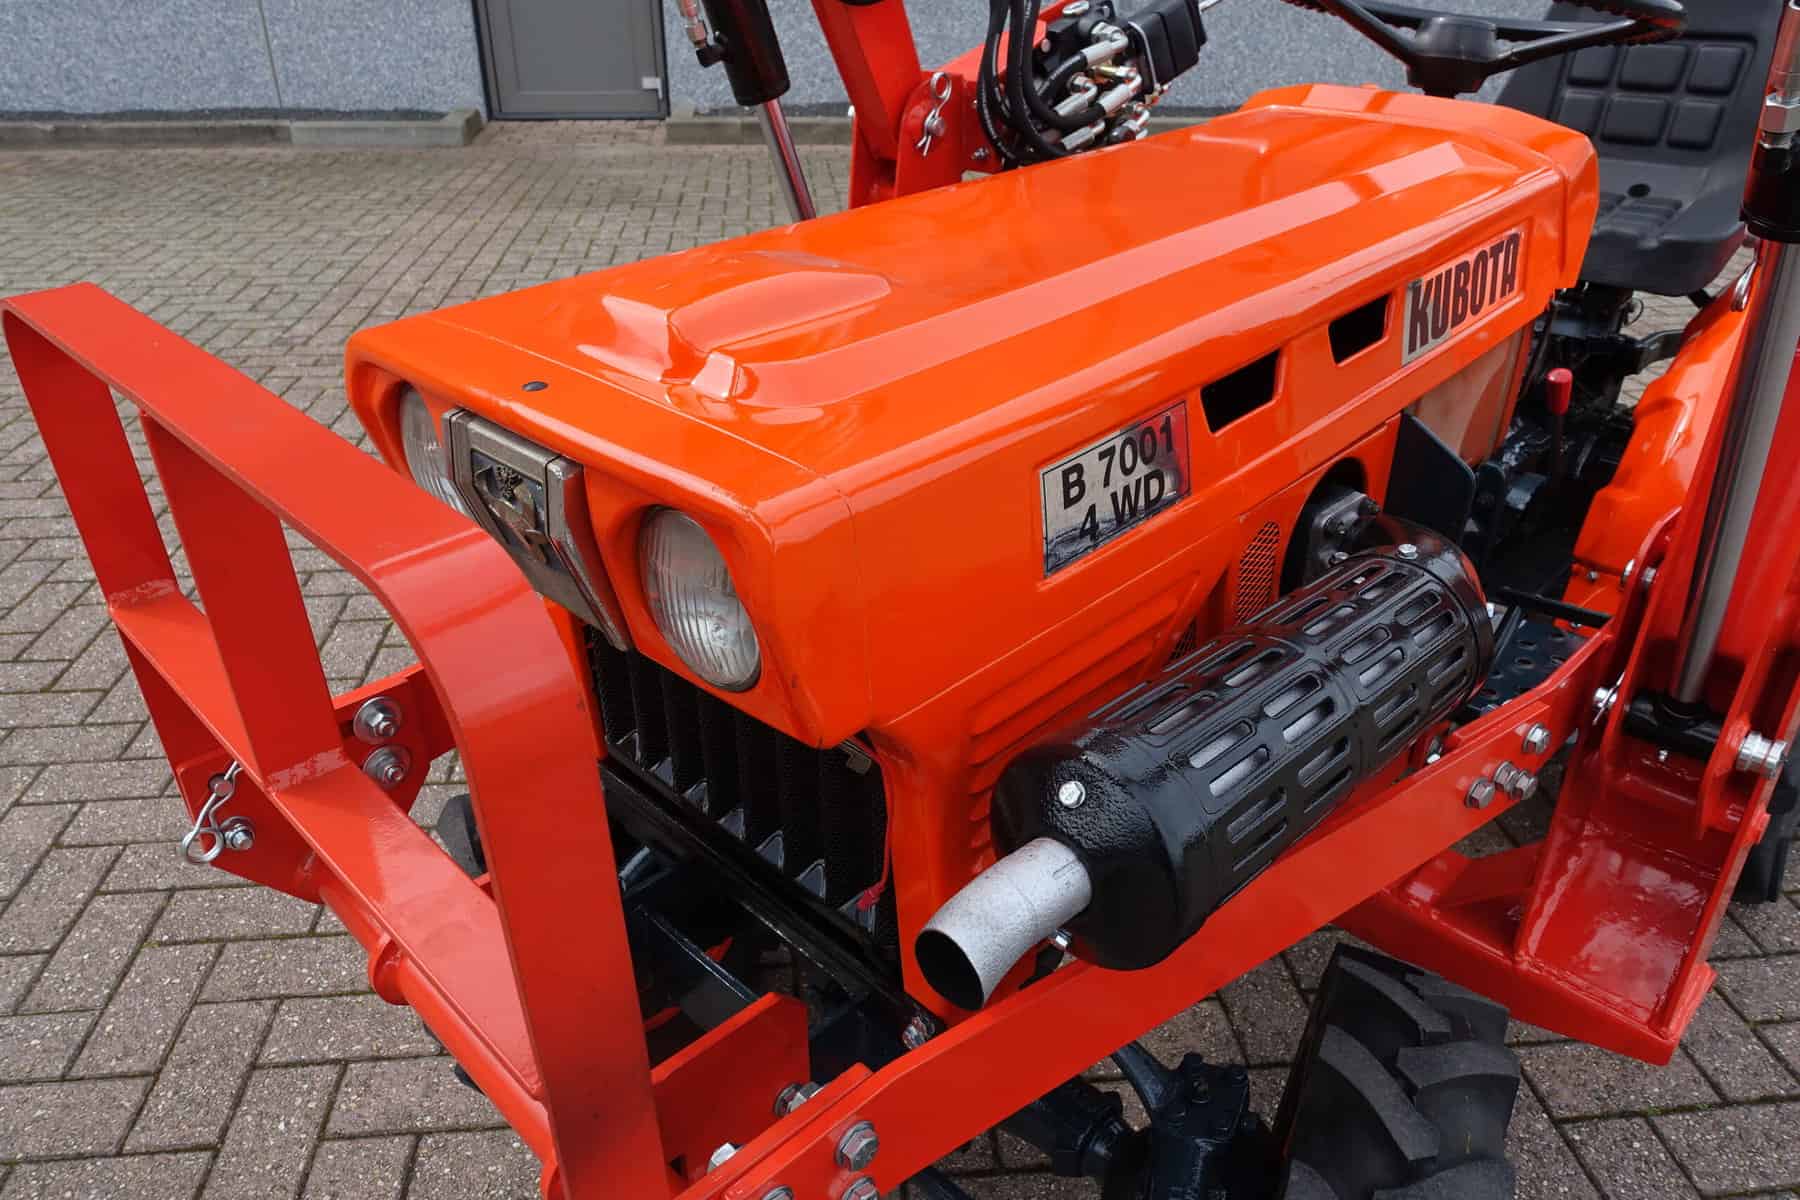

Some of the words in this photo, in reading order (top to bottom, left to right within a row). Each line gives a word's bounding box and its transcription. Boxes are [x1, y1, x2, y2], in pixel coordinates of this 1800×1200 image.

[1408, 233, 1520, 355] KUBOTA
[1062, 462, 1086, 510] B
[1098, 416, 1173, 488] 7001
[1080, 503, 1099, 542] 4
[1110, 468, 1165, 525] WD
